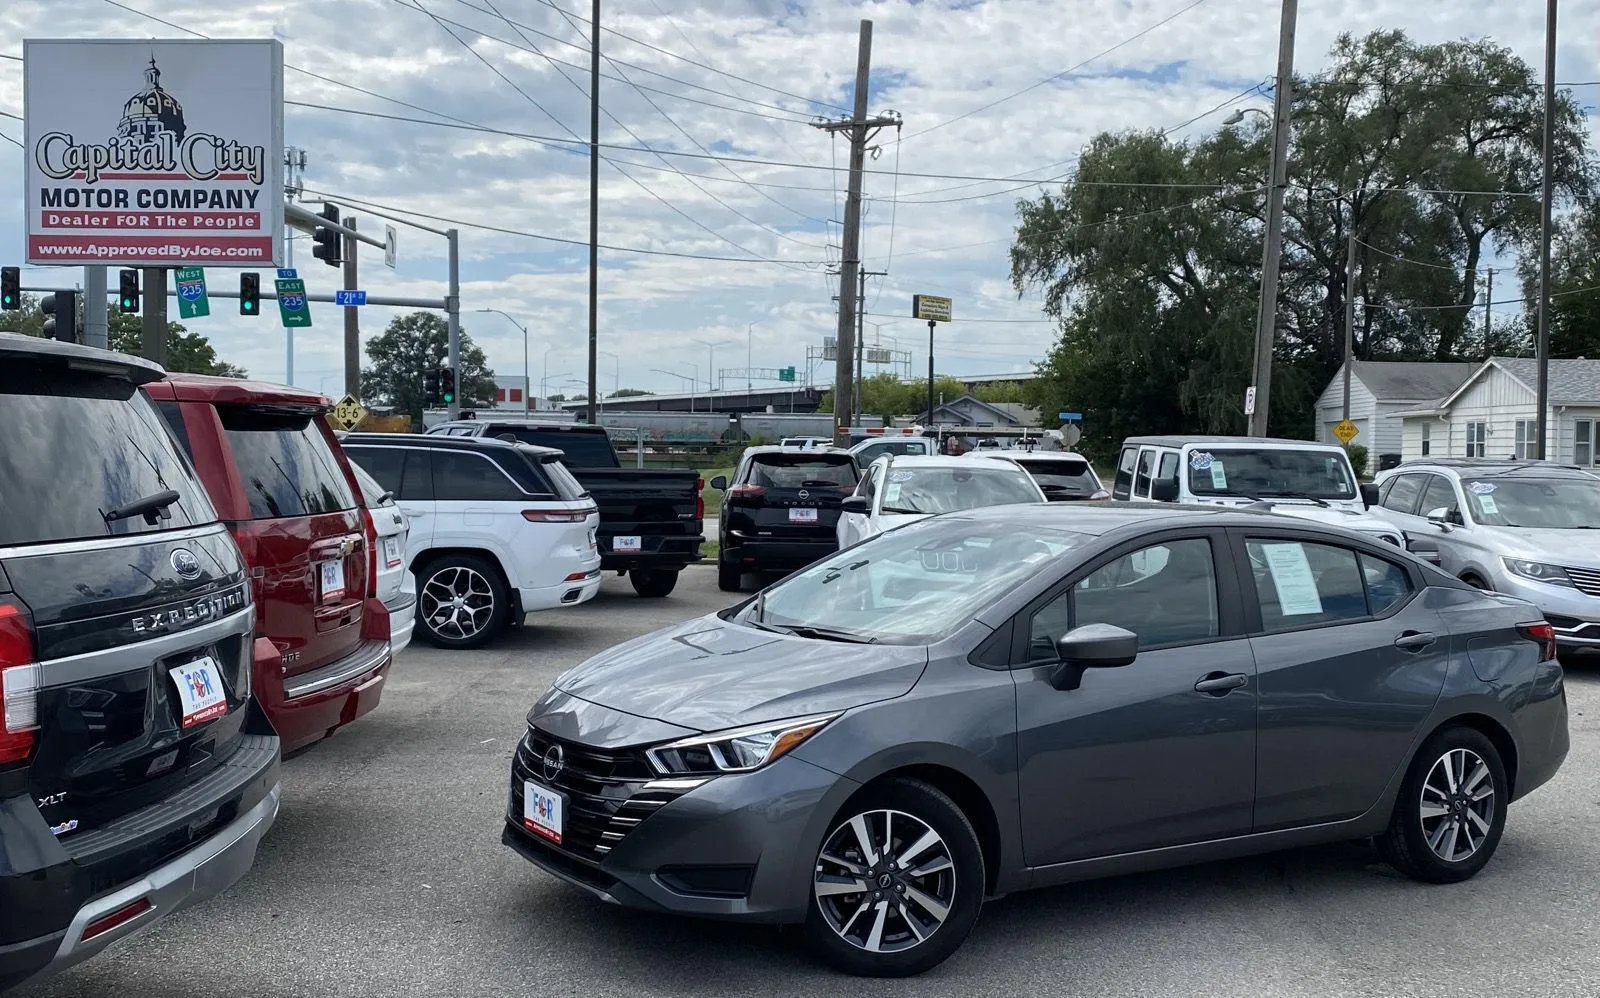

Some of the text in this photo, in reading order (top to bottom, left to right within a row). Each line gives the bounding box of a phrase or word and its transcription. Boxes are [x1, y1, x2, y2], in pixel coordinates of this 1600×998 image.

[35, 131, 265, 185] Capital City
[41, 188, 260, 209] MOTOR COMPANY
[49, 214, 254, 229] Dealer FOR The People
[38, 244, 263, 258] www.ApprovedByJoe.com
[182, 284, 202, 296] 235
[283, 296, 303, 306] 235
[184, 668, 215, 702] FOR
[38, 791, 67, 808] XLT
[533, 792, 554, 822] FOR
